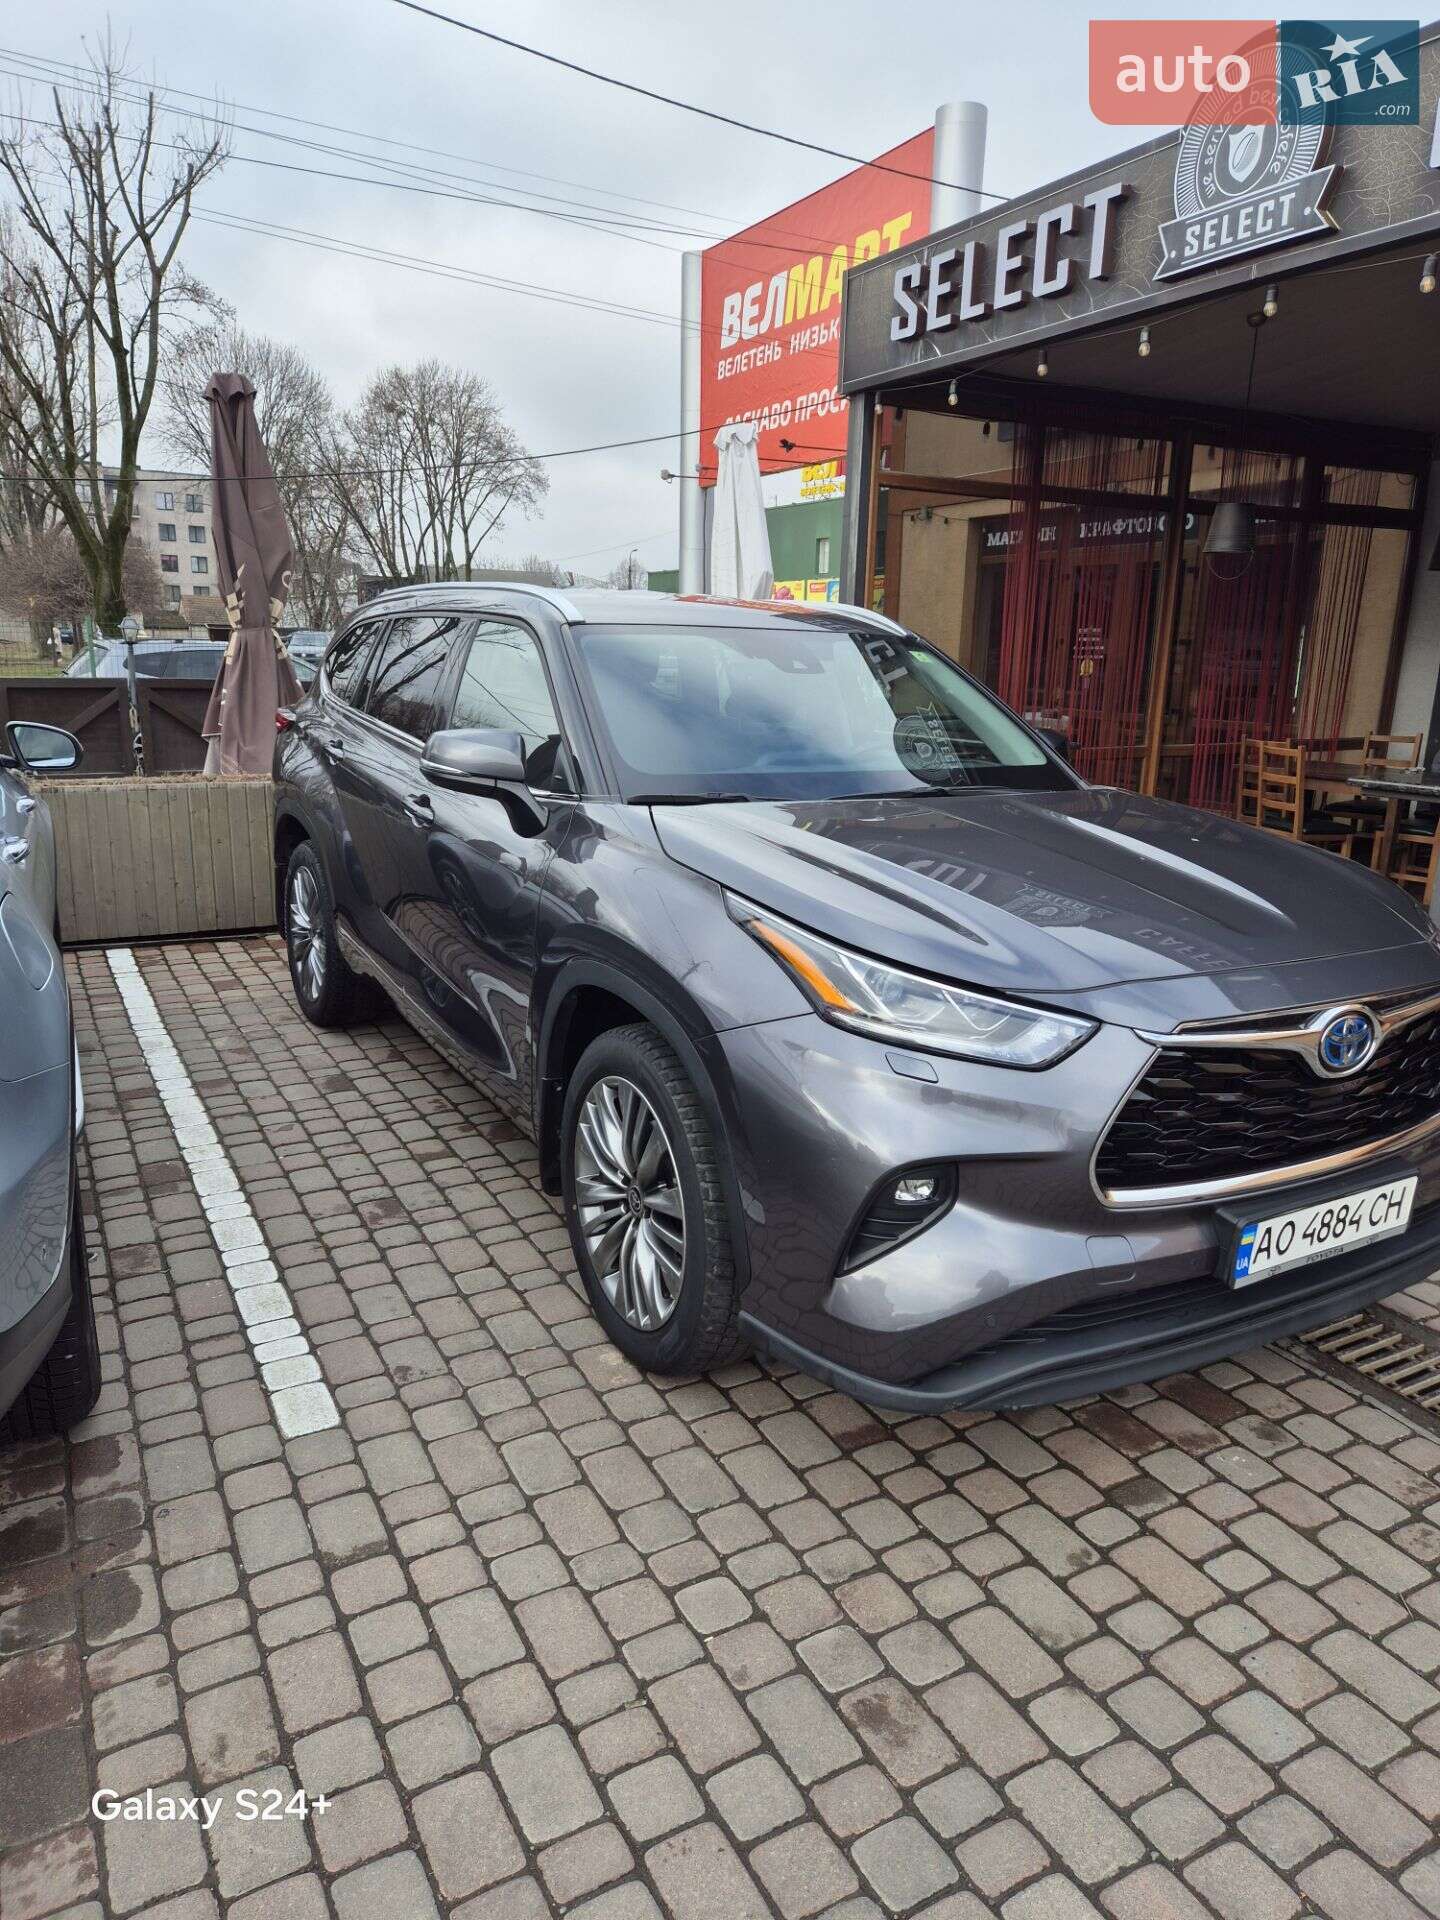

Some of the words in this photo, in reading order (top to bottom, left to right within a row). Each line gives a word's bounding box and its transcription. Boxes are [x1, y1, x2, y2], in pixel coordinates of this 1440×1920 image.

[1184, 192, 1296, 257] SELECT
[890, 182, 1123, 342] SELECT
[717, 340, 782, 381] ВЕЛЕТЕНЬ
[789, 317, 841, 355] НИЗЬК
[726, 399, 792, 433] КАВО
[1252, 1221, 1296, 1264] AO
[1301, 1199, 1367, 1247] 4884
[1368, 1186, 1408, 1227] CH
[1236, 1256, 1250, 1270] UA
